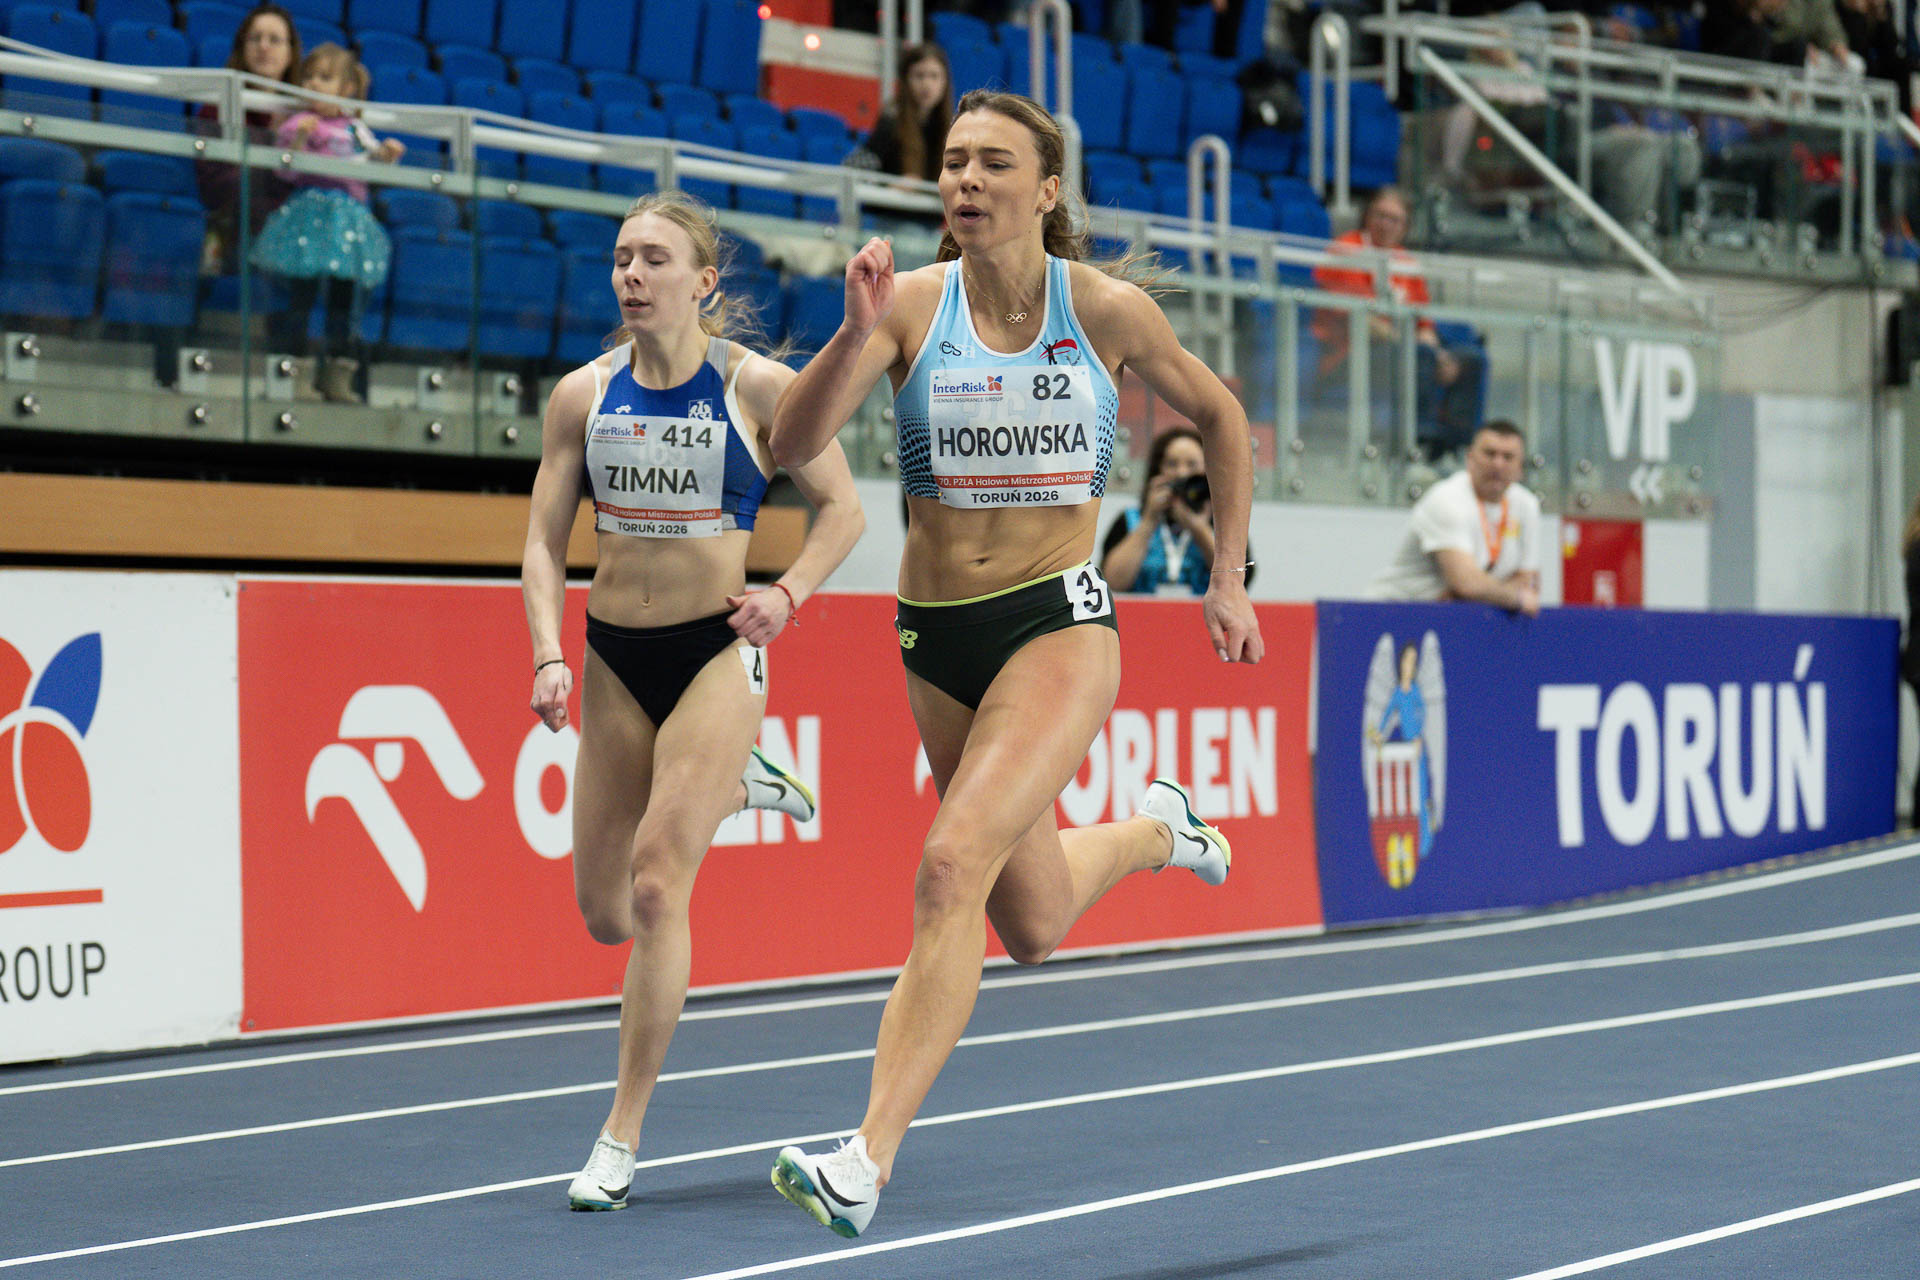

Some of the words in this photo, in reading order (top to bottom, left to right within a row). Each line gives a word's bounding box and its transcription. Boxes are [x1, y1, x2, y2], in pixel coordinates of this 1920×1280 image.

[933, 381, 986, 394] InterRisk
[1032, 373, 1072, 400] 82
[1594, 337, 1698, 462] VIP
[661, 424, 712, 449] 414
[937, 423, 1089, 457] HOROWSKA
[605, 465, 700, 494] ZIMNA
[953, 478, 974, 486] PZLA
[975, 477, 1009, 486] Halowe
[1010, 474, 1064, 485] Mistrzostwa
[1065, 472, 1091, 483] Polski
[971, 489, 1023, 504] TORUŃ
[1024, 490, 1059, 502] 2026
[617, 521, 656, 534] TORUŃ
[658, 524, 688, 535] 2026
[647, 511, 693, 520] Mistrzostwa
[694, 510, 716, 519] Polski
[1076, 570, 1103, 614] 3
[752, 649, 763, 691] 4
[1536, 643, 1827, 847] TORUŃ
